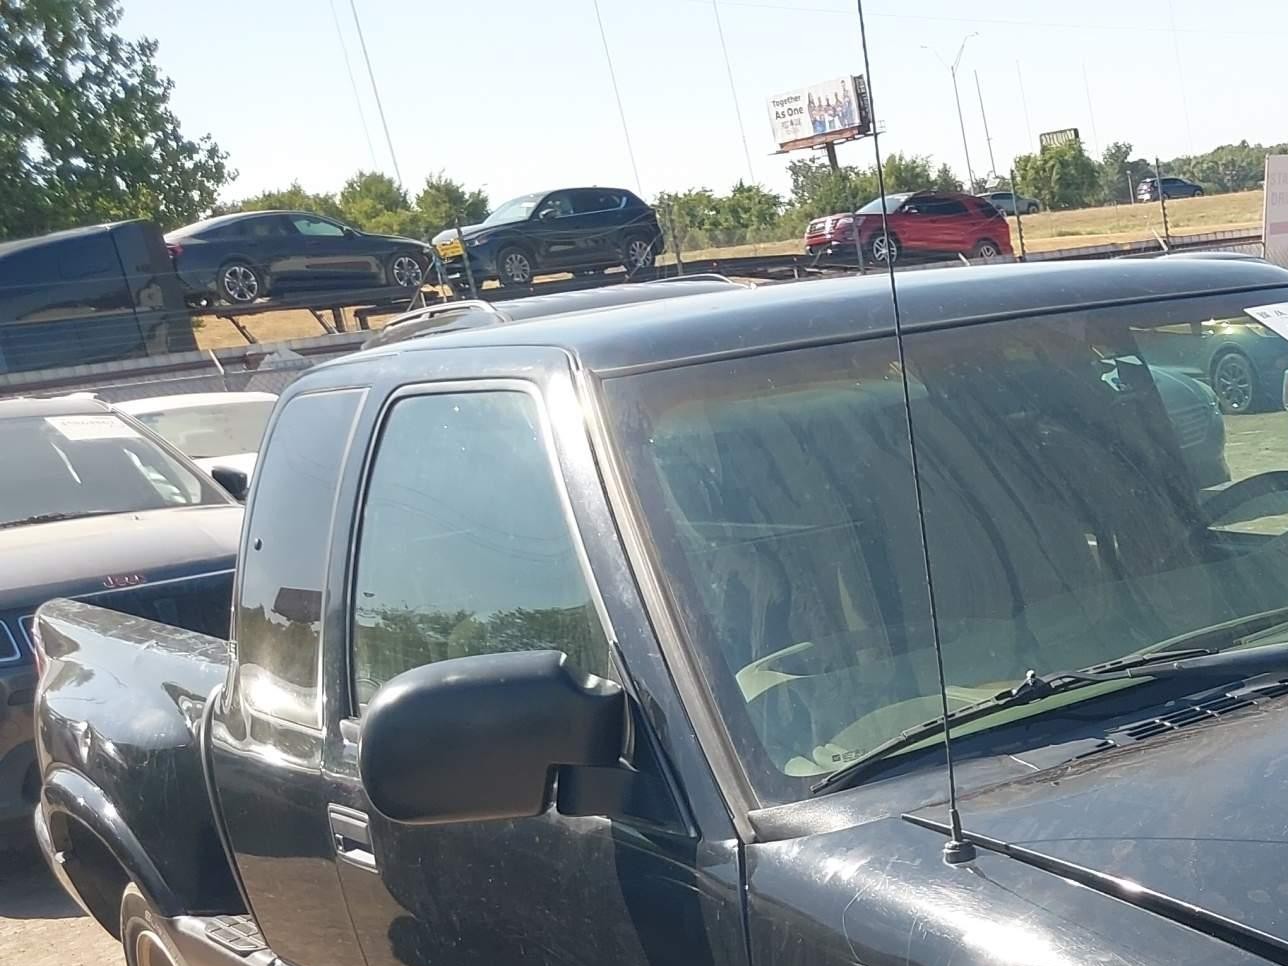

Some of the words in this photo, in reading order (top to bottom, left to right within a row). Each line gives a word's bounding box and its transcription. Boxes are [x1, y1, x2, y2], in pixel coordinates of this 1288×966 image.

[772, 95, 801, 108] Together
[775, 110, 786, 120] As
[786, 106, 804, 117] One
